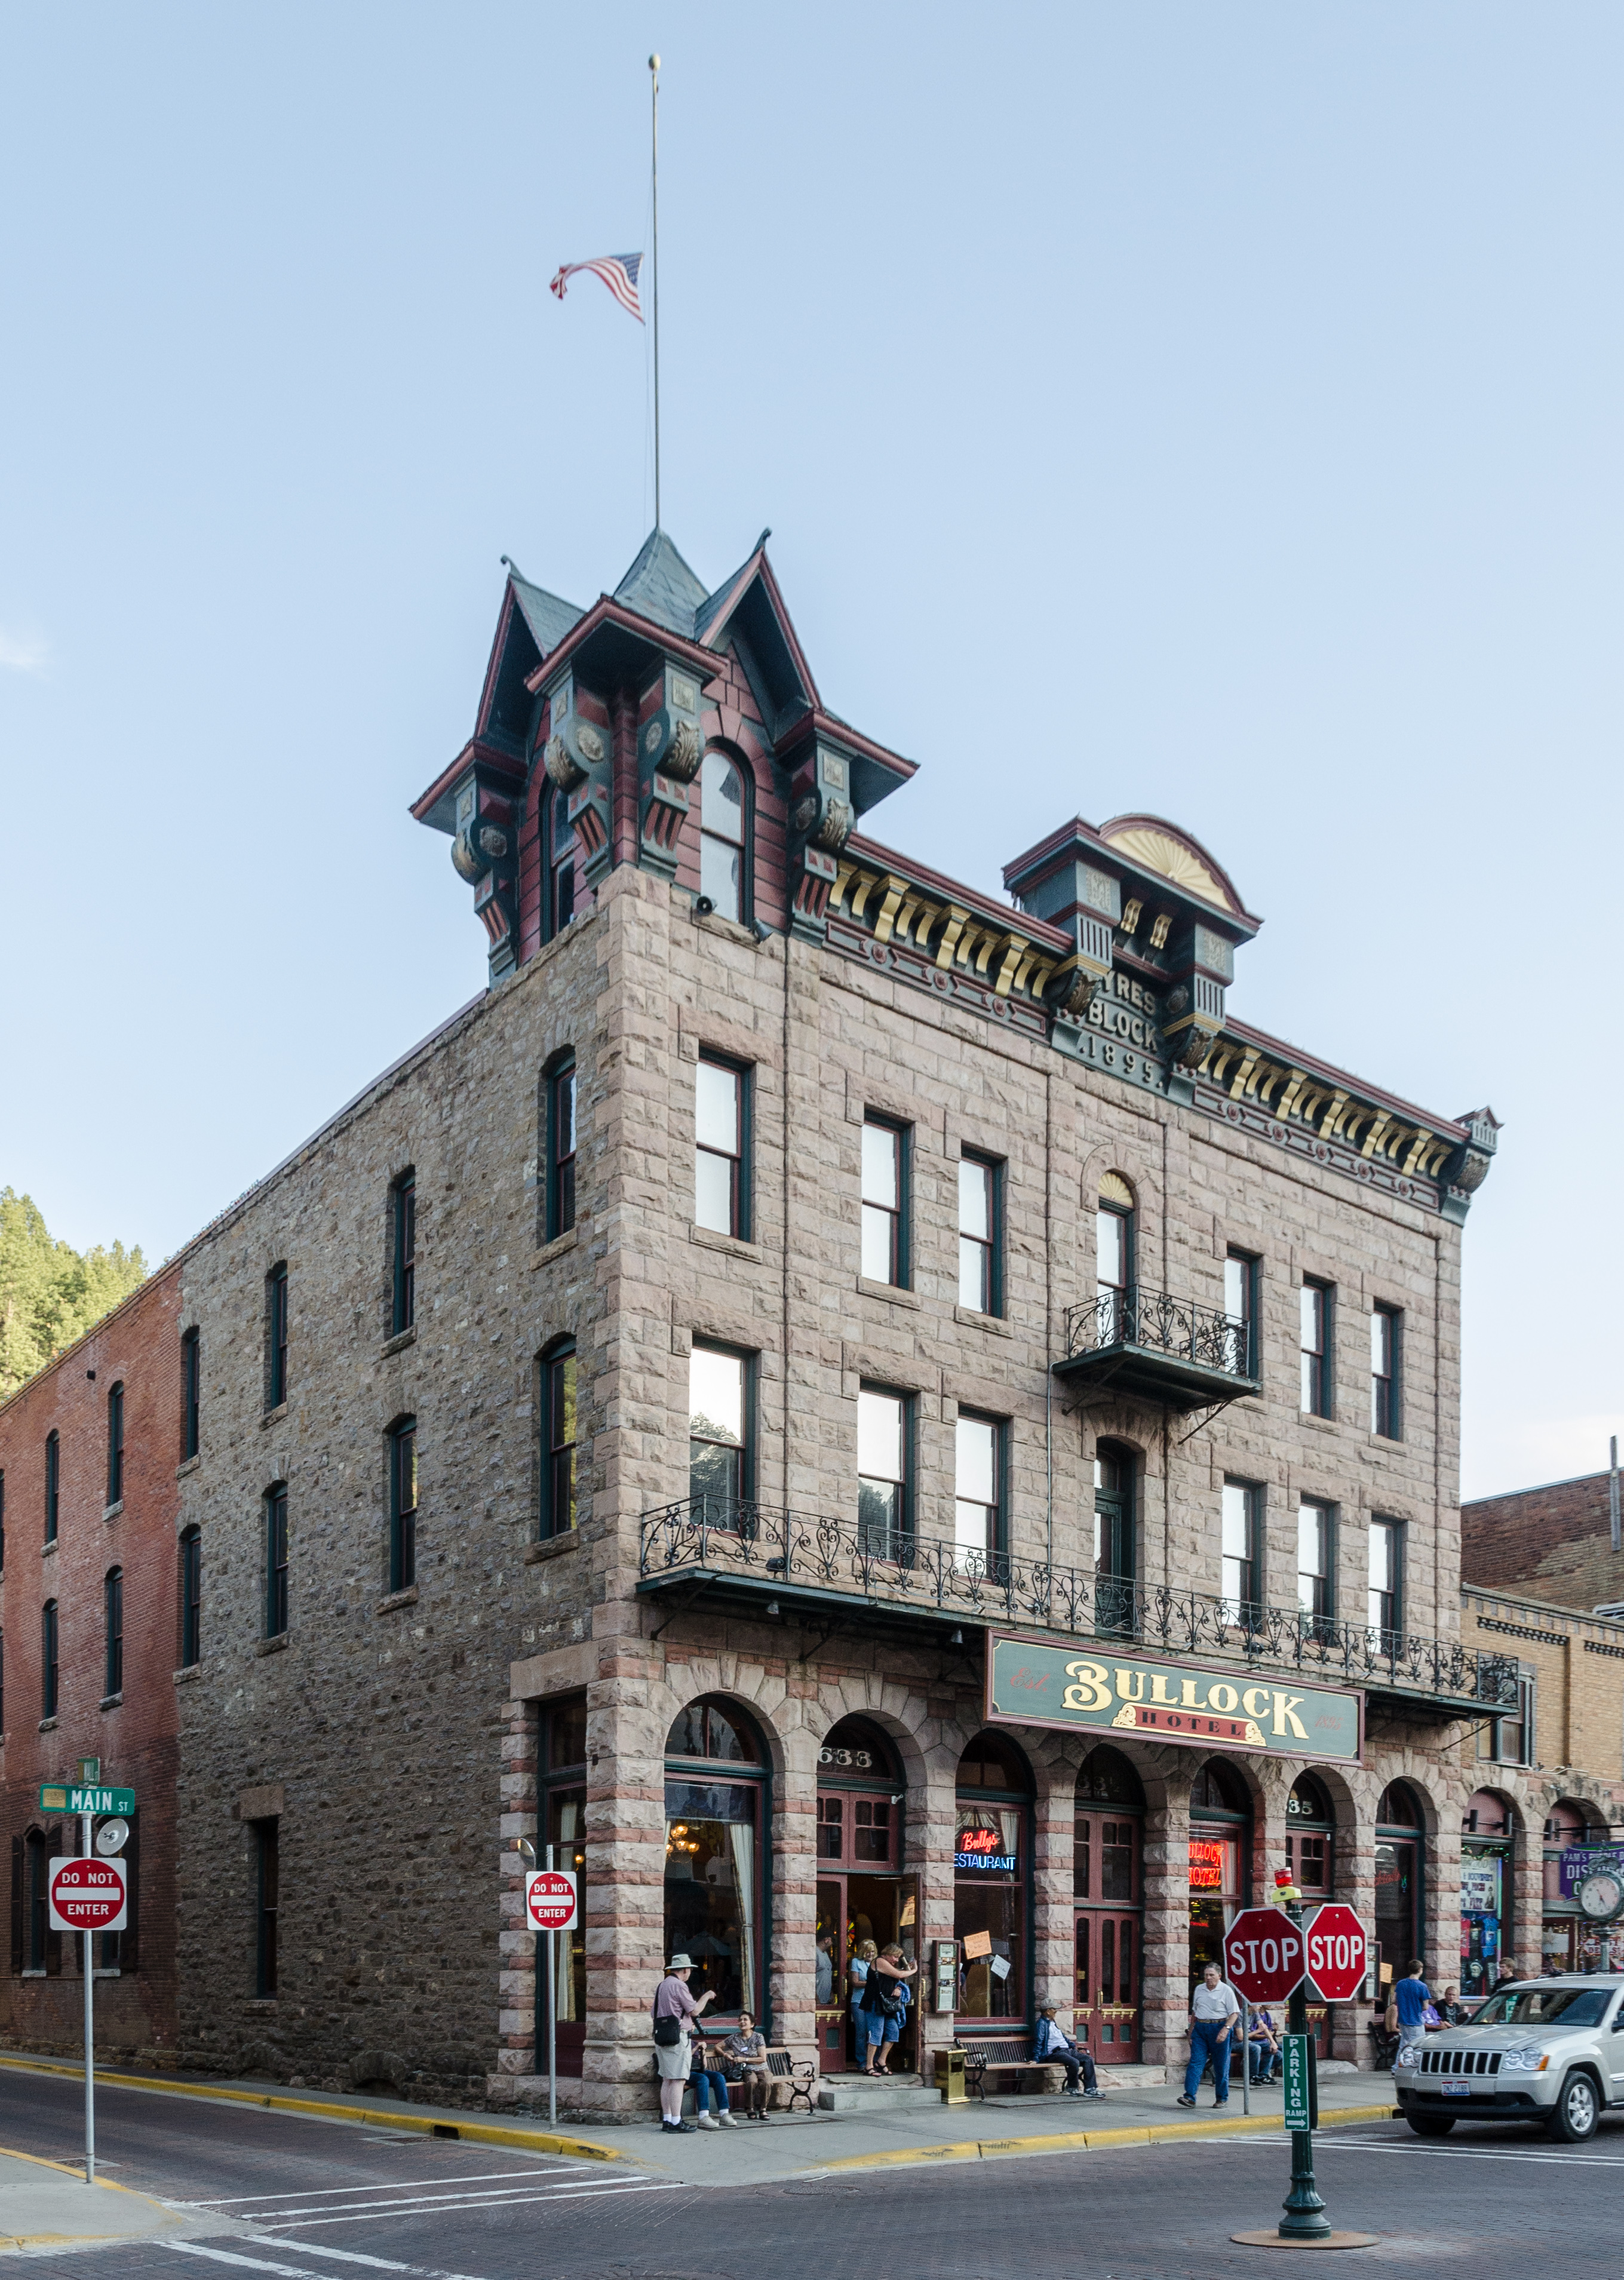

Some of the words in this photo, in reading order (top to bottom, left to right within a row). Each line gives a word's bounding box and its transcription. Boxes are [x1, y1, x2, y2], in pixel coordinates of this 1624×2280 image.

[1103, 971, 1156, 1015] YRES
[1088, 997, 1158, 1052] BLOCK
[1010, 1667, 1050, 1692] Est.
[1061, 1660, 1309, 1740] BULLOCK
[1315, 1714, 1344, 1731] 1895
[1142, 1711, 1241, 1736] HOTEL
[818, 1747, 872, 1767] 633
[71, 1790, 112, 1811] MAIN
[118, 1802, 128, 1812] ST
[1288, 1799, 1313, 1815] 35
[953, 1853, 1016, 1870] ESTAURANT
[1189, 1843, 1224, 1867] ULLOCK
[62, 1872, 80, 1884] DO
[88, 1873, 114, 1884] NOT
[534, 1883, 547, 1893] DO
[551, 1883, 569, 1893] NOT
[67, 1904, 109, 1915] ENTER
[538, 1908, 566, 1918] ENTER
[1230, 1937, 1299, 1975] STOP
[1310, 1935, 1363, 1971] STOP
[1289, 2038, 1301, 2107] PARKING
